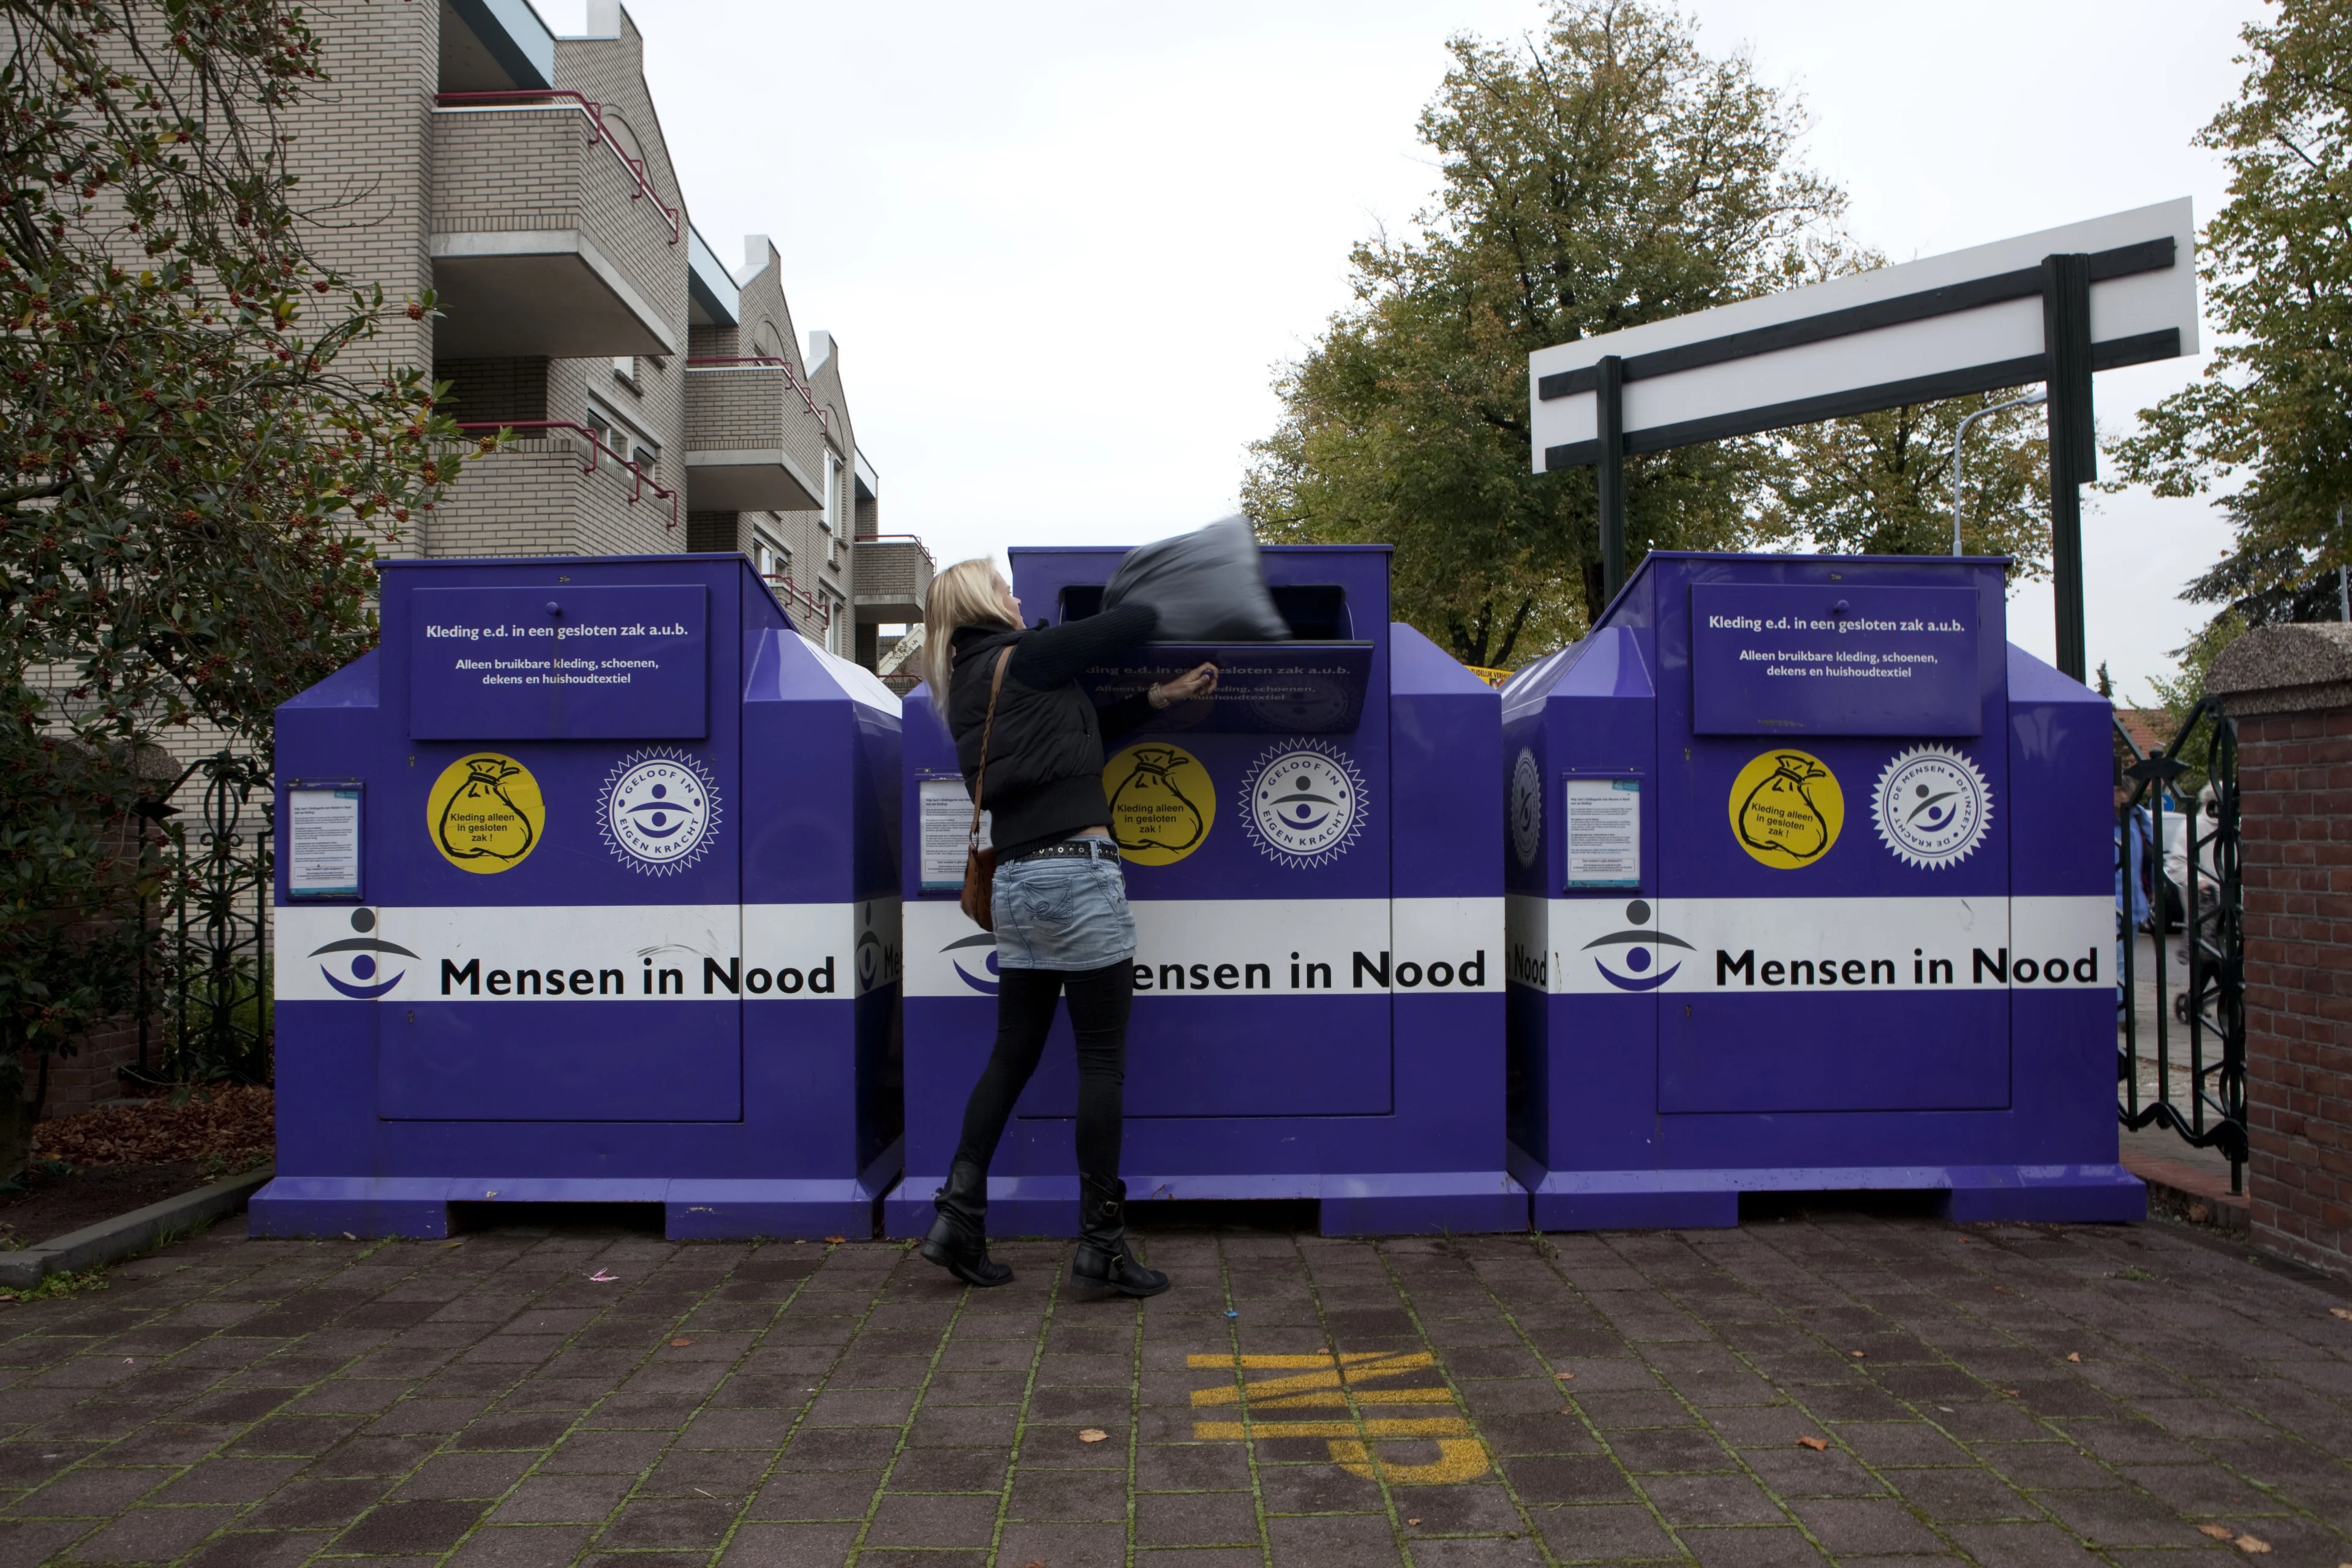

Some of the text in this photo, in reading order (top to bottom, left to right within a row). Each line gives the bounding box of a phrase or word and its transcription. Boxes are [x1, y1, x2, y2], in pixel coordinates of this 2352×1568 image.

[427, 622, 688, 640] Kleding e.d. in een gesloten zak a.u.b.
[1709, 616, 1964, 633] Kleding e.d. in een gesloten zak a.u.b.
[456, 658, 658, 671] Alleen bruikbare kleding, schoenen,
[1740, 650, 1937, 665] Alleen bruikbare kleding, schoenen,
[483, 674, 522, 684] dekens
[543, 673, 630, 684] huishoudtextiel
[1084, 666, 1119, 675] ding
[1218, 666, 1272, 674] esloten
[1767, 666, 1806, 676] dekens
[1826, 666, 1911, 677] huishoudtextiel
[625, 769, 695, 794] GELOOF IN
[1268, 761, 1340, 786] GELOOF IN
[1893, 765, 1945, 801] DE MENSEN
[1117, 803, 1185, 814] Kleding alleen
[1751, 802, 1813, 822] Kleding alleen
[1956, 778, 1972, 831] DE INZET
[450, 812, 515, 823] Kleding alleen
[1125, 814, 1177, 825] in gesloten
[1756, 813, 1804, 831] in gesloten
[457, 823, 508, 834] in gesloten
[620, 818, 699, 853] EIGEN KRACHT
[1263, 810, 1344, 846] EIGEN KRACHT
[1768, 828, 1783, 837] zak
[1894, 818, 1950, 847] DE KRACHT
[471, 833, 488, 842] zak
[1133, 949, 1485, 990] ensen in Nood
[1514, 942, 1547, 987] Nood
[1717, 947, 2098, 986] Mensen in Nood
[441, 956, 835, 996] Mensen in Nood
